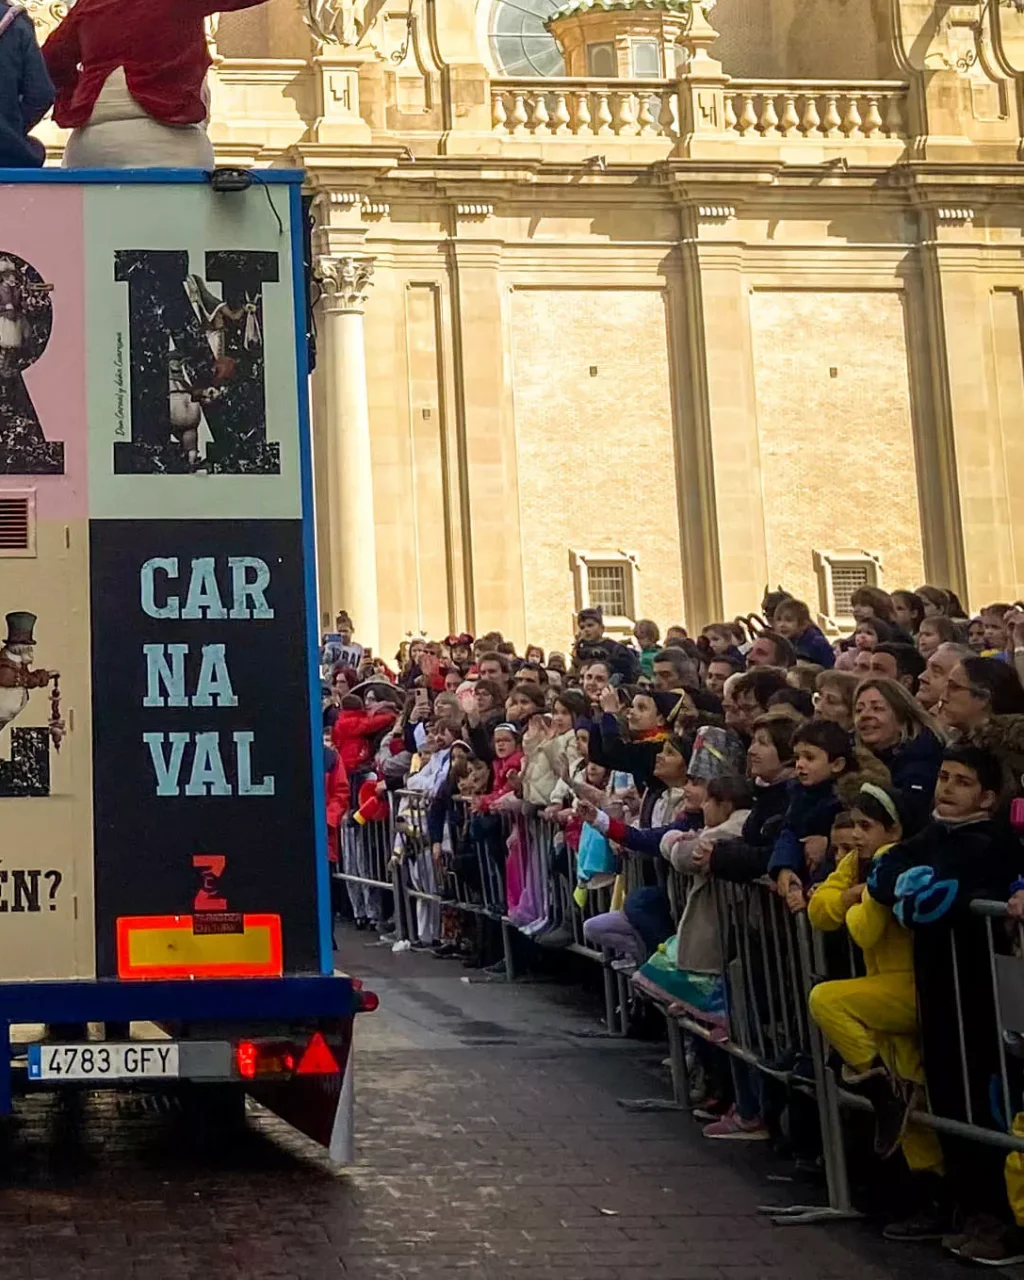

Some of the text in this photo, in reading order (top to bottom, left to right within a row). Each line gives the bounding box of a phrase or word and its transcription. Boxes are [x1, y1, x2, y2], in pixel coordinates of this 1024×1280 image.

[114, 250, 280, 475] N
[140, 556, 275, 619] CAR
[143, 643, 239, 707] NA
[143, 731, 275, 796] VAL
[49, 1047, 171, 1074] 4783 GFY
